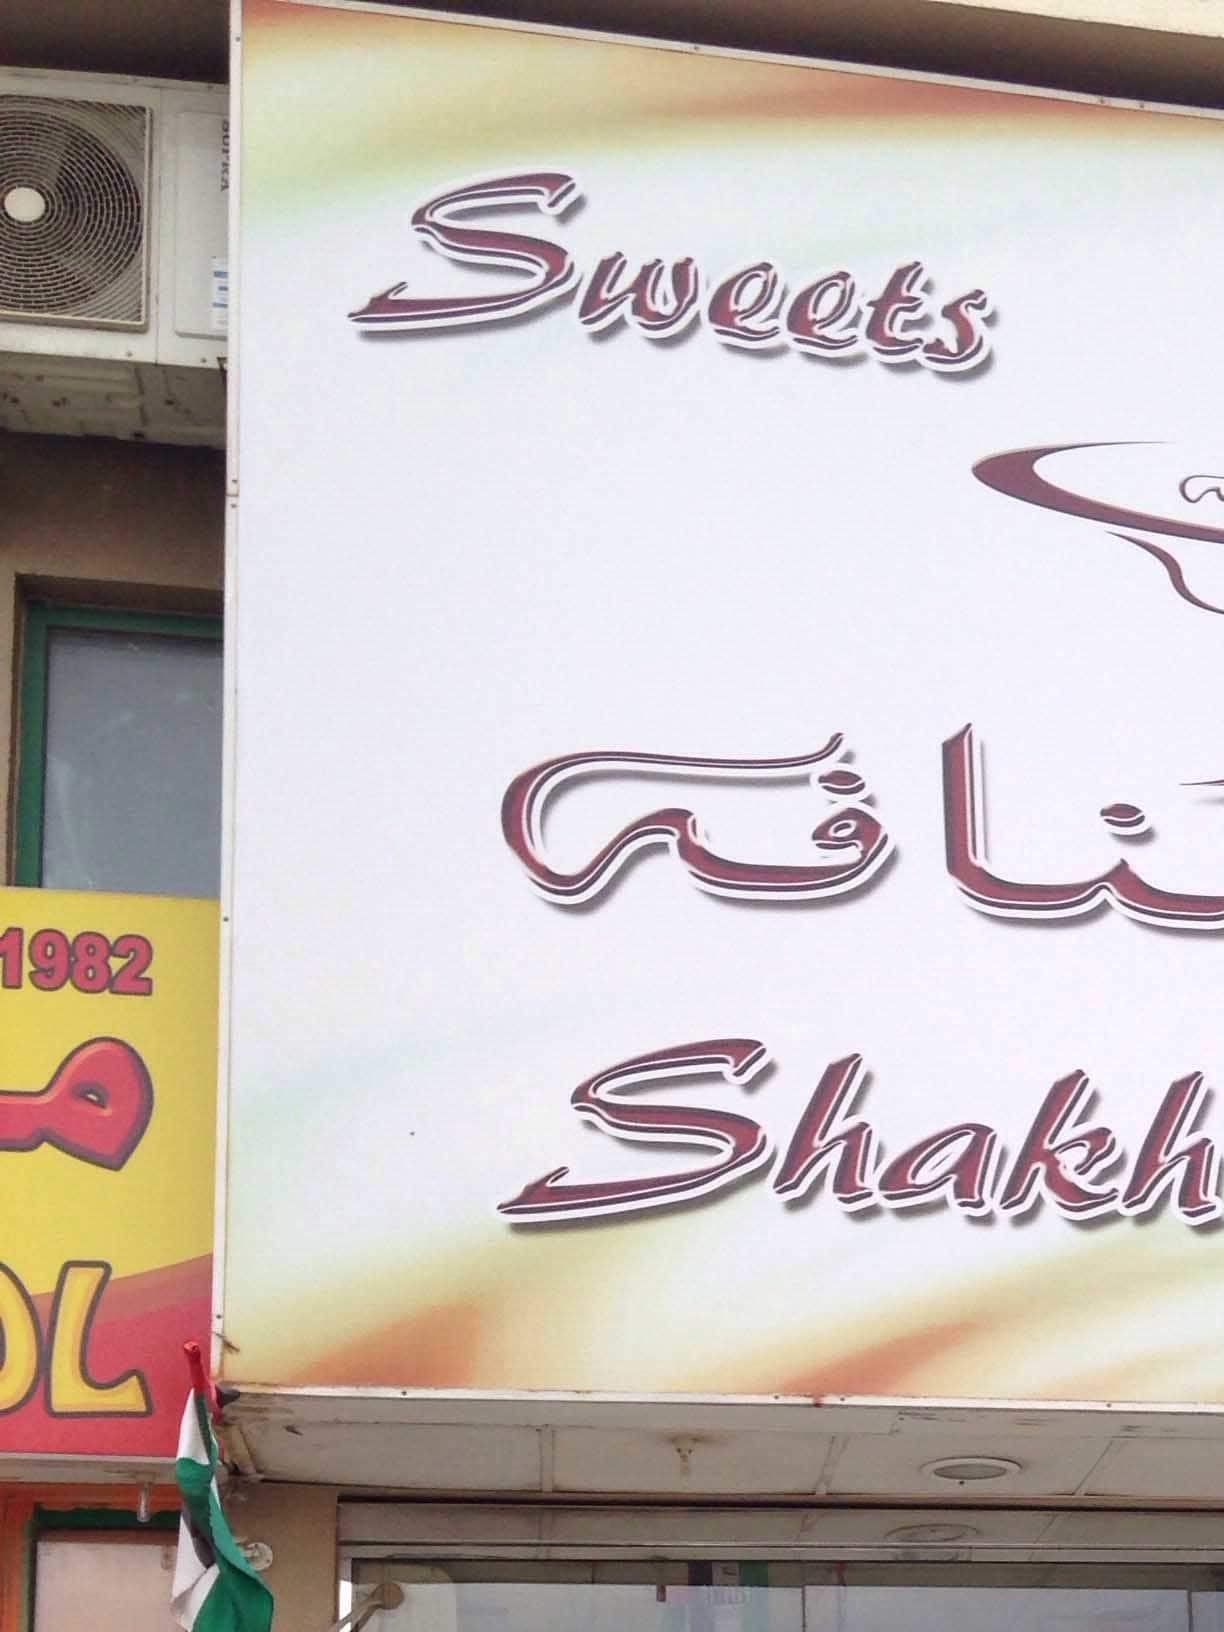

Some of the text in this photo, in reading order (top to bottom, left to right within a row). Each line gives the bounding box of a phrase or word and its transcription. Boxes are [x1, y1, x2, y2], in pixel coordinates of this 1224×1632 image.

[348, 171, 994, 374] Sweets
[0, 927, 153, 997] 1982
[494, 1037, 1220, 1222] Shakh
